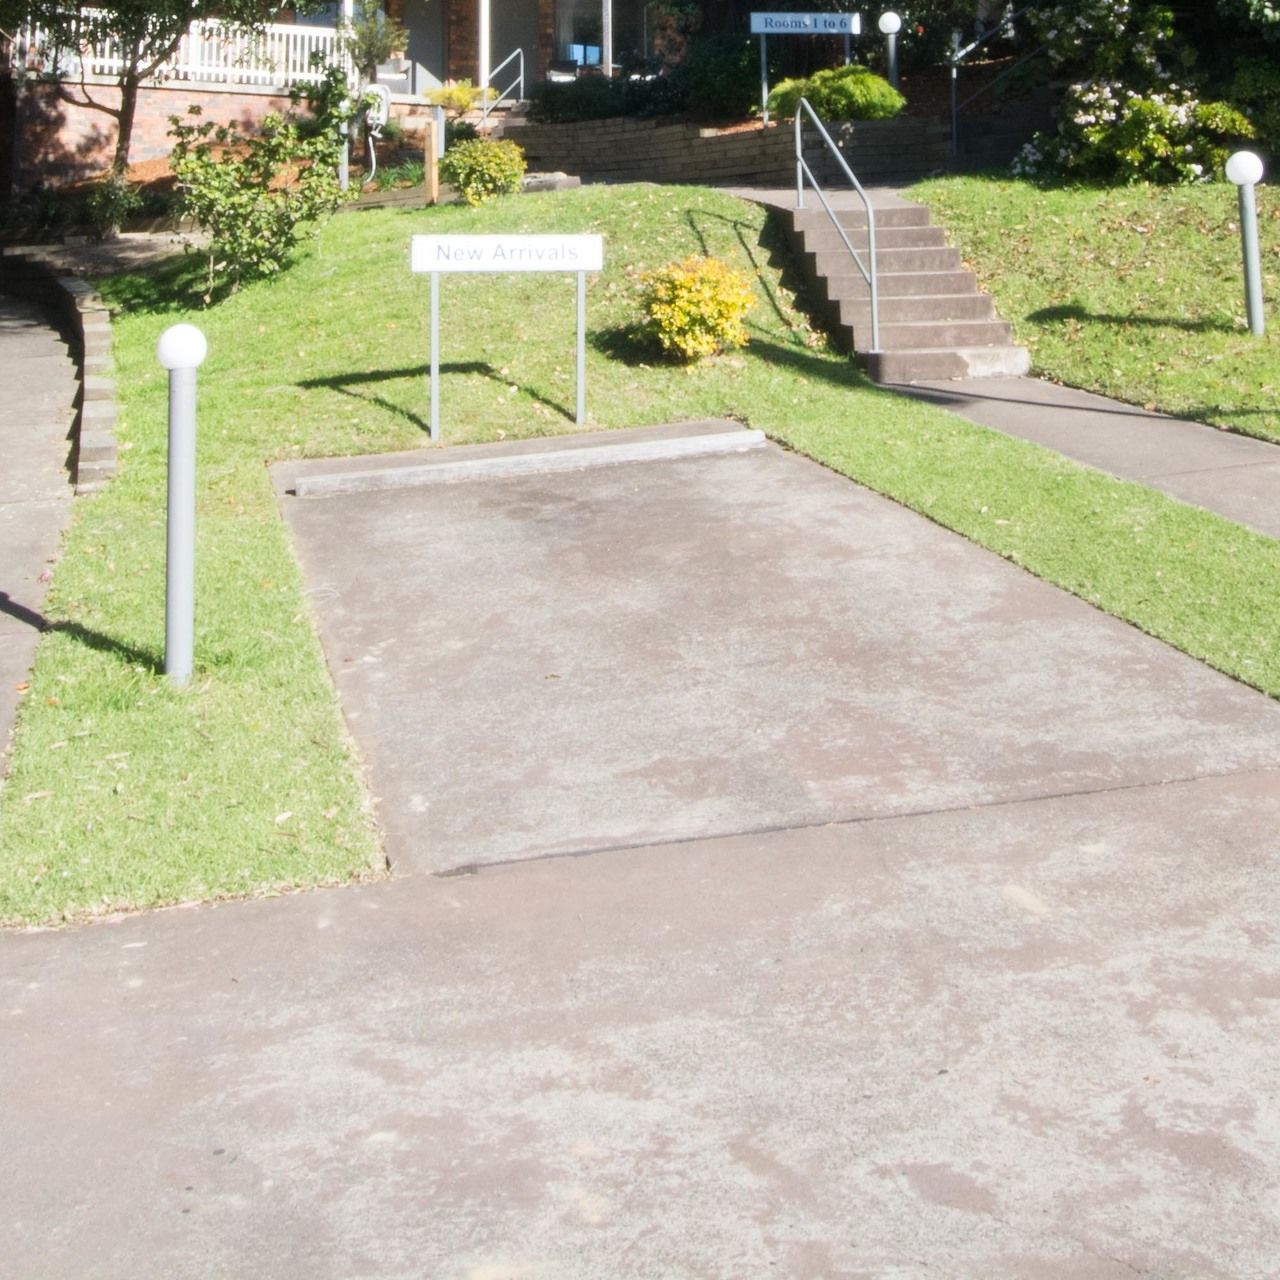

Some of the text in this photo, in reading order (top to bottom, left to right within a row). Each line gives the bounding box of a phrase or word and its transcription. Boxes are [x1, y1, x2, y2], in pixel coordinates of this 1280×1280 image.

[764, 18, 808, 29] Rooms
[823, 18, 835, 29] to
[839, 18, 847, 29] 6
[436, 244, 579, 261] New Arrivals
